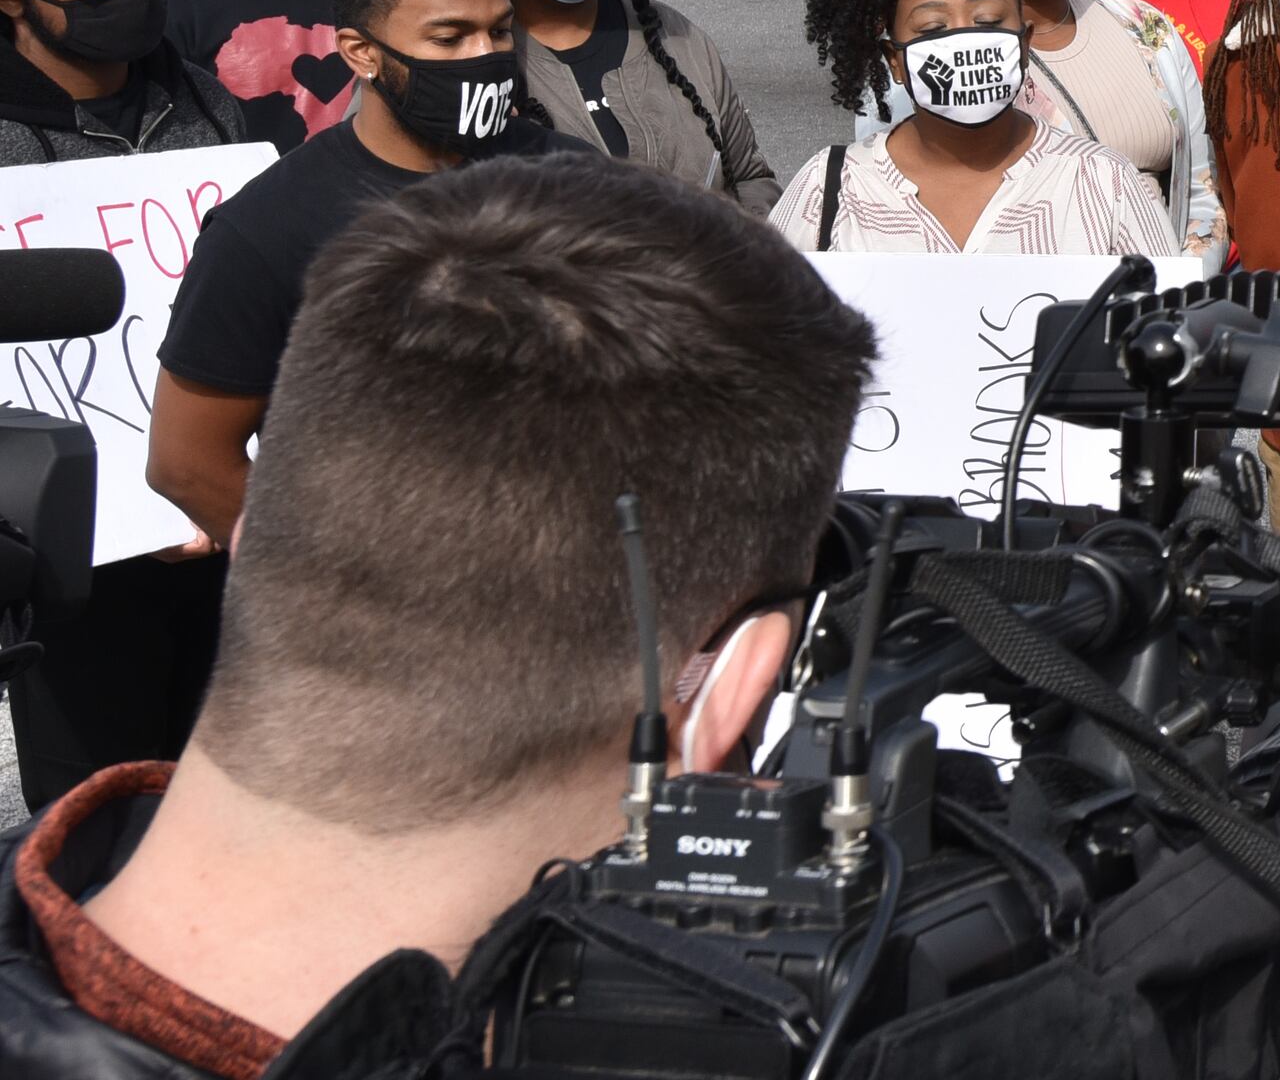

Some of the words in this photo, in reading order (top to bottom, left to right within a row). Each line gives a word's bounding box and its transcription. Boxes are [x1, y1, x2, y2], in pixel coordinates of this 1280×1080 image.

[953, 47, 1004, 67] BLACK
[960, 66, 1003, 87] LIVES
[953, 84, 1011, 106] MATTER
[459, 78, 513, 138] VOTE
[677, 835, 752, 857] SONY
